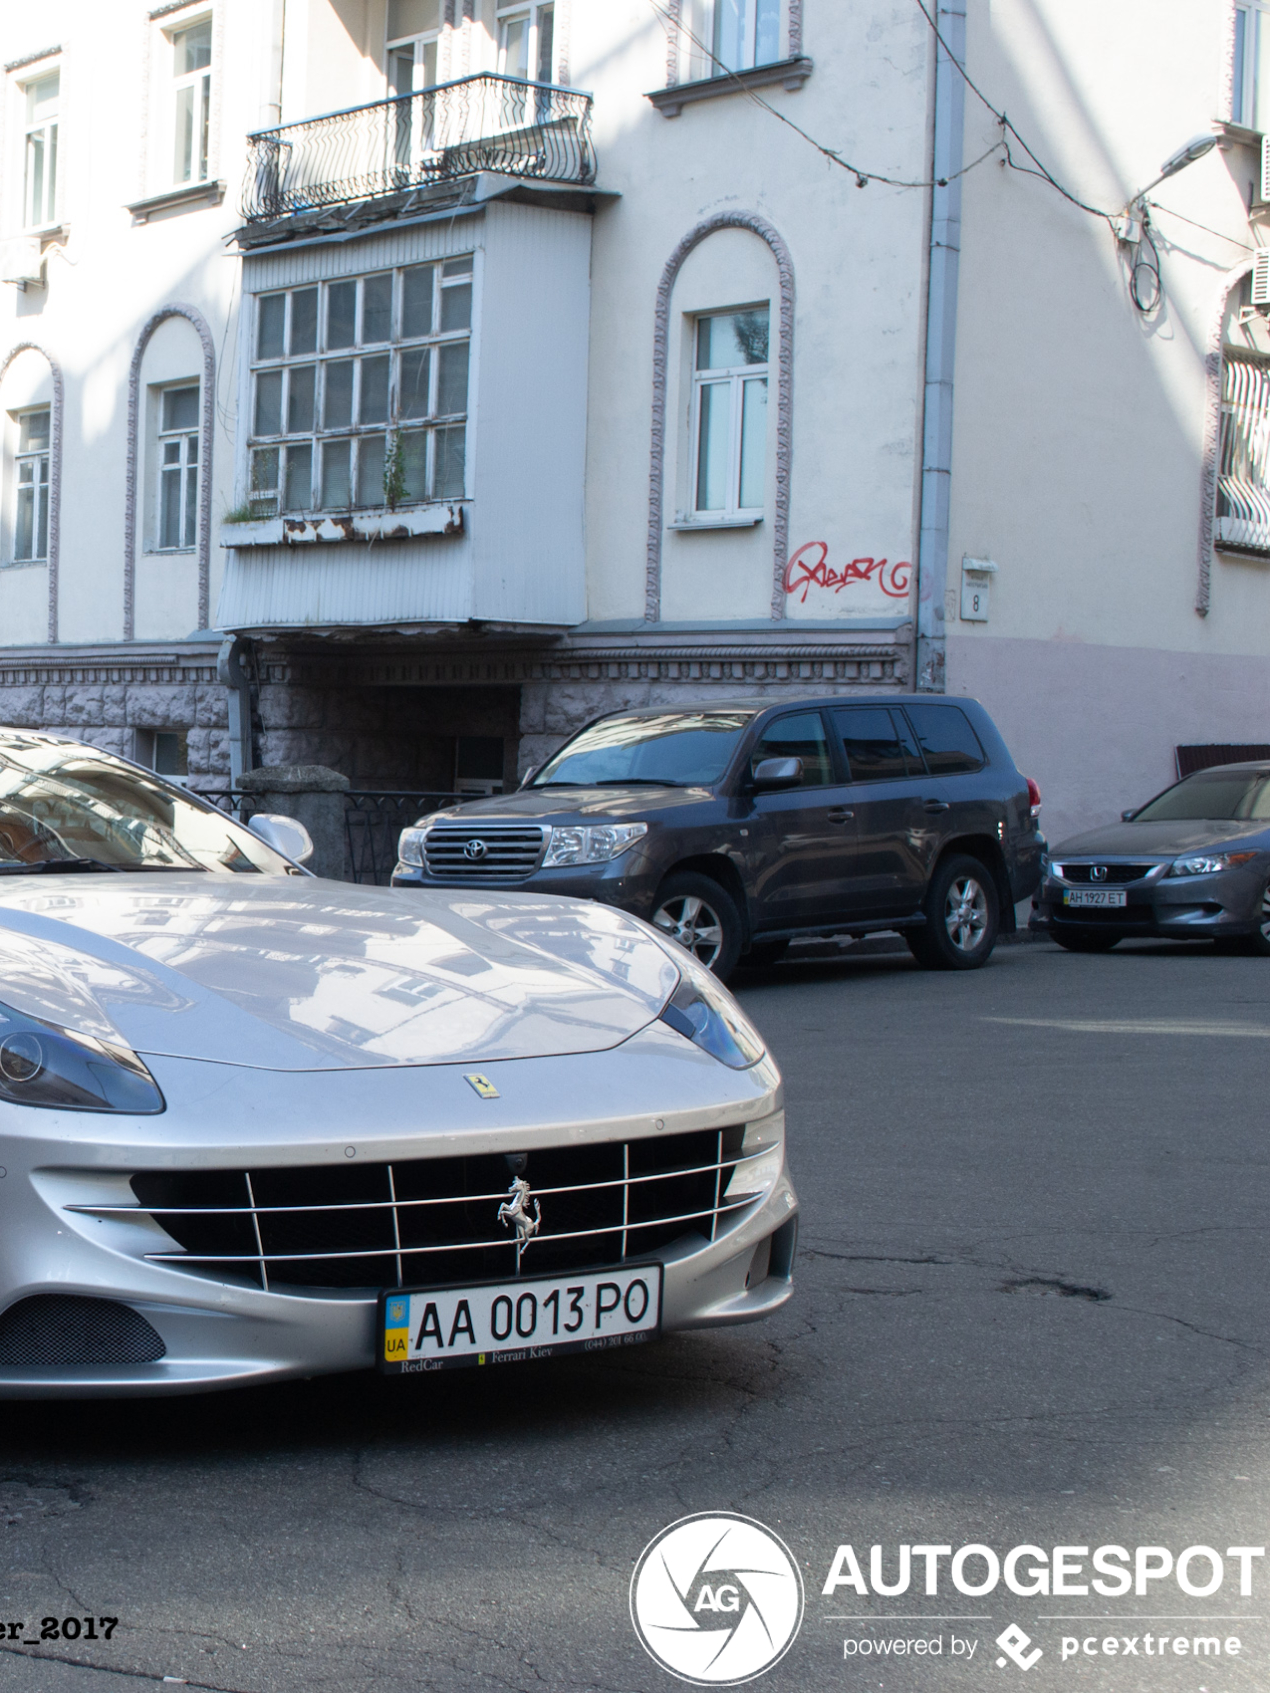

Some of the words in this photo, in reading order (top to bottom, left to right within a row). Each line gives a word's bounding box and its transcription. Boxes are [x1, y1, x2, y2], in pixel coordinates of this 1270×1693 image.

[973, 594, 980, 612] 8
[1070, 892, 1083, 903] AH
[1084, 892, 1106, 904] 1927
[1108, 893, 1124, 904] ET
[415, 1299, 476, 1350] AA
[491, 1286, 585, 1341] 0013
[595, 1279, 649, 1329] PO
[387, 1338, 406, 1353] UA
[400, 1359, 444, 1373] RedCar
[491, 1351, 526, 1363] Ferrari
[529, 1346, 553, 1358] Kiev
